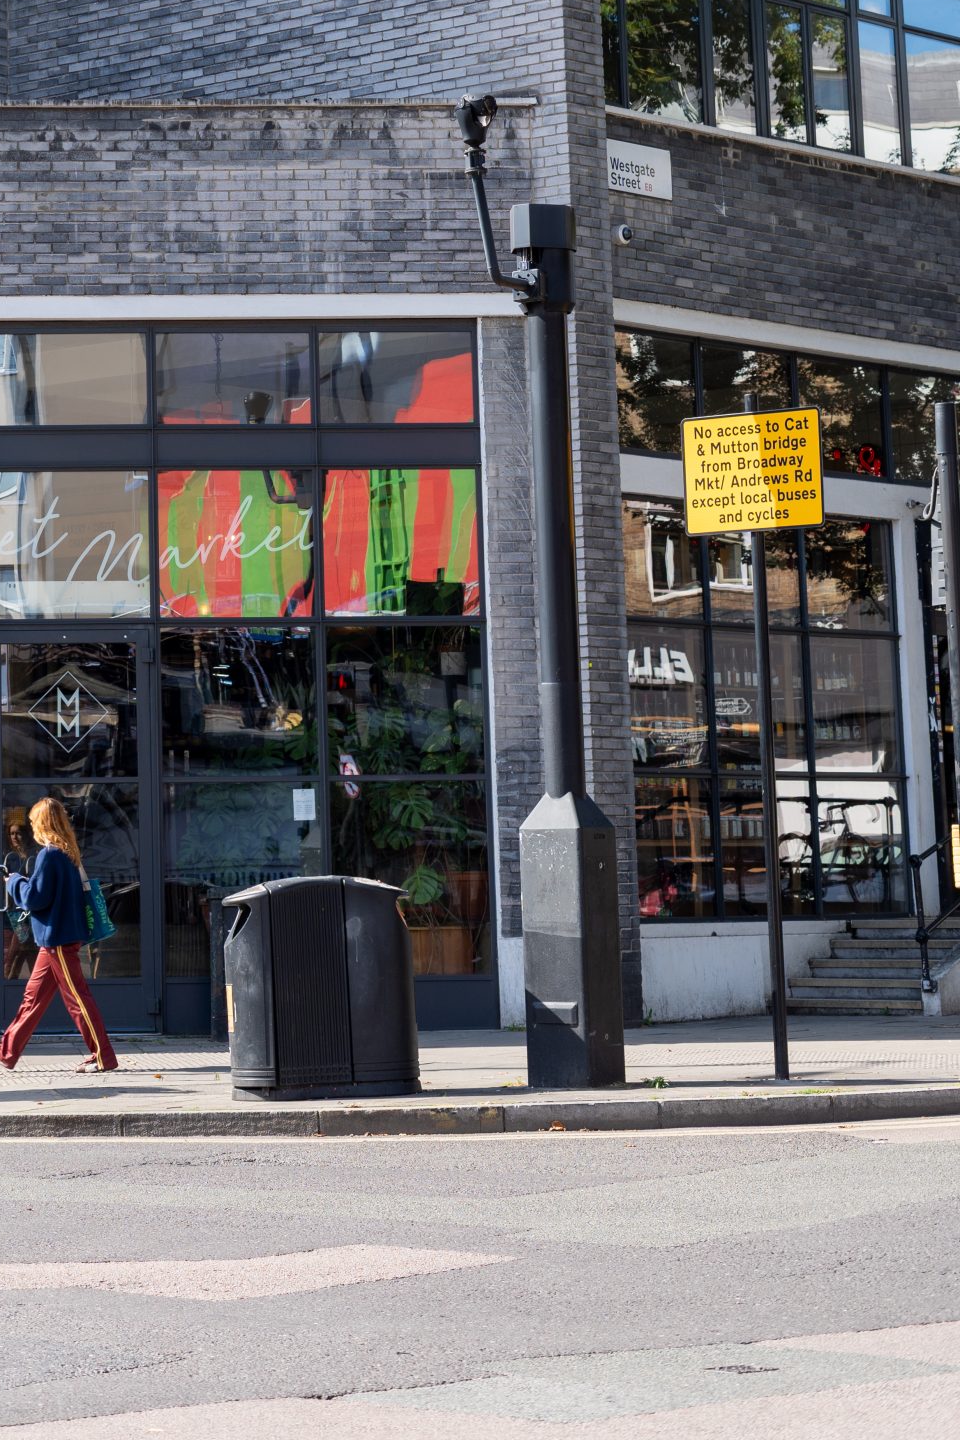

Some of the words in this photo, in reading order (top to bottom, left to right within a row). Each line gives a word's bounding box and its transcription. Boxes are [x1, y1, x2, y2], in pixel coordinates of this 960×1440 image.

[610, 156, 655, 177] Westgate
[610, 171, 641, 190] Street
[694, 426, 712, 439] No
[717, 423, 761, 437] access
[766, 420, 779, 433] to
[784, 417, 809, 431] Cat
[697, 444, 705, 456] &
[710, 440, 759, 455] Mutton
[763, 436, 807, 451] bridge
[700, 461, 731, 473] from
[737, 455, 804, 470] Broadway
[695, 475, 725, 491] Mkt/
[730, 474, 789, 488] Andrews
[794, 469, 813, 482] Rd
[691, 493, 735, 508] except
[740, 490, 772, 505] local
[777, 489, 817, 502] buses
[719, 510, 742, 523] and
[747, 508, 790, 523] cycles
[59, 494, 314, 596] Market
